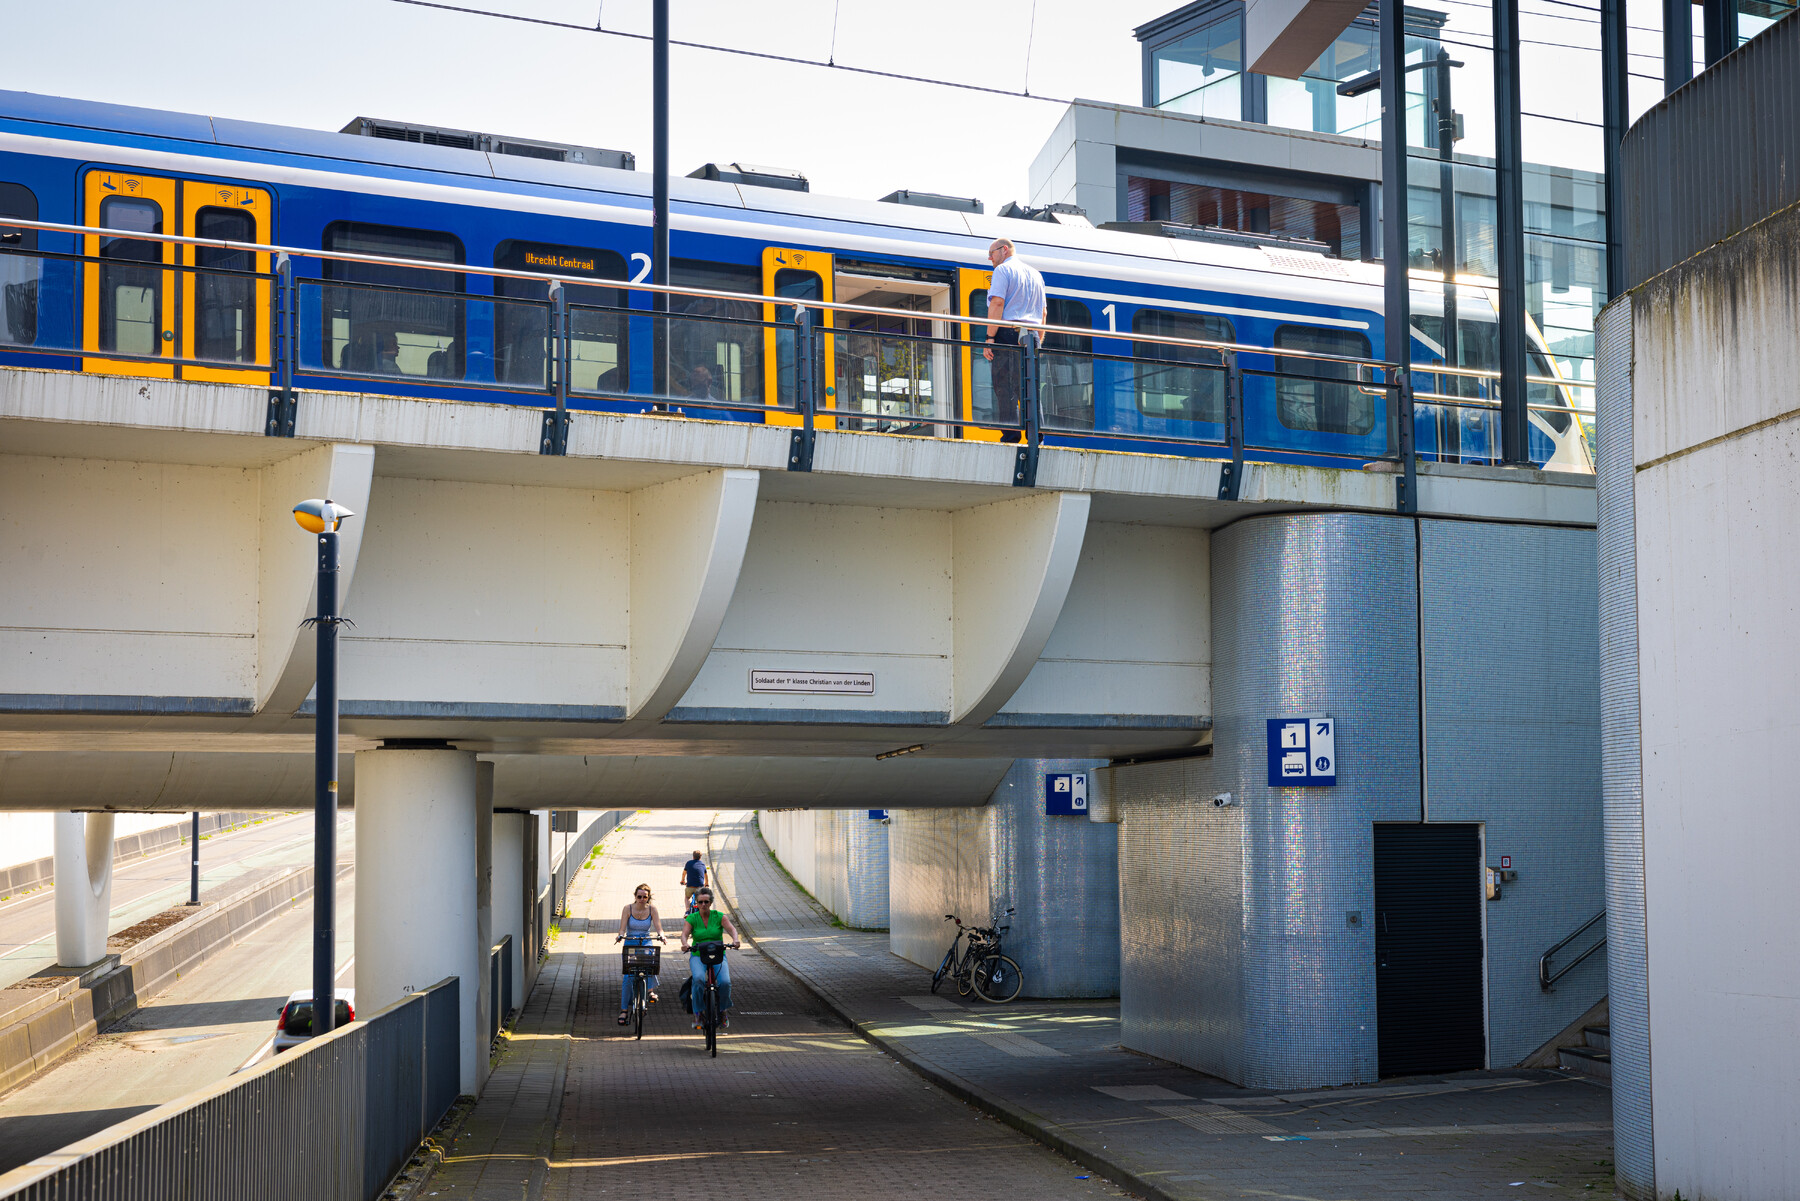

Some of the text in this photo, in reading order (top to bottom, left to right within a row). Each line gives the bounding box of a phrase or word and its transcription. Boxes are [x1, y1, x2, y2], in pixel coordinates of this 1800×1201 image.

[525, 252, 594, 270] Utrecht Centraal
[630, 252, 652, 283] 2
[1102, 304, 1116, 333] 1
[1290, 732, 1296, 745] 1
[1059, 782, 1065, 791] 2
